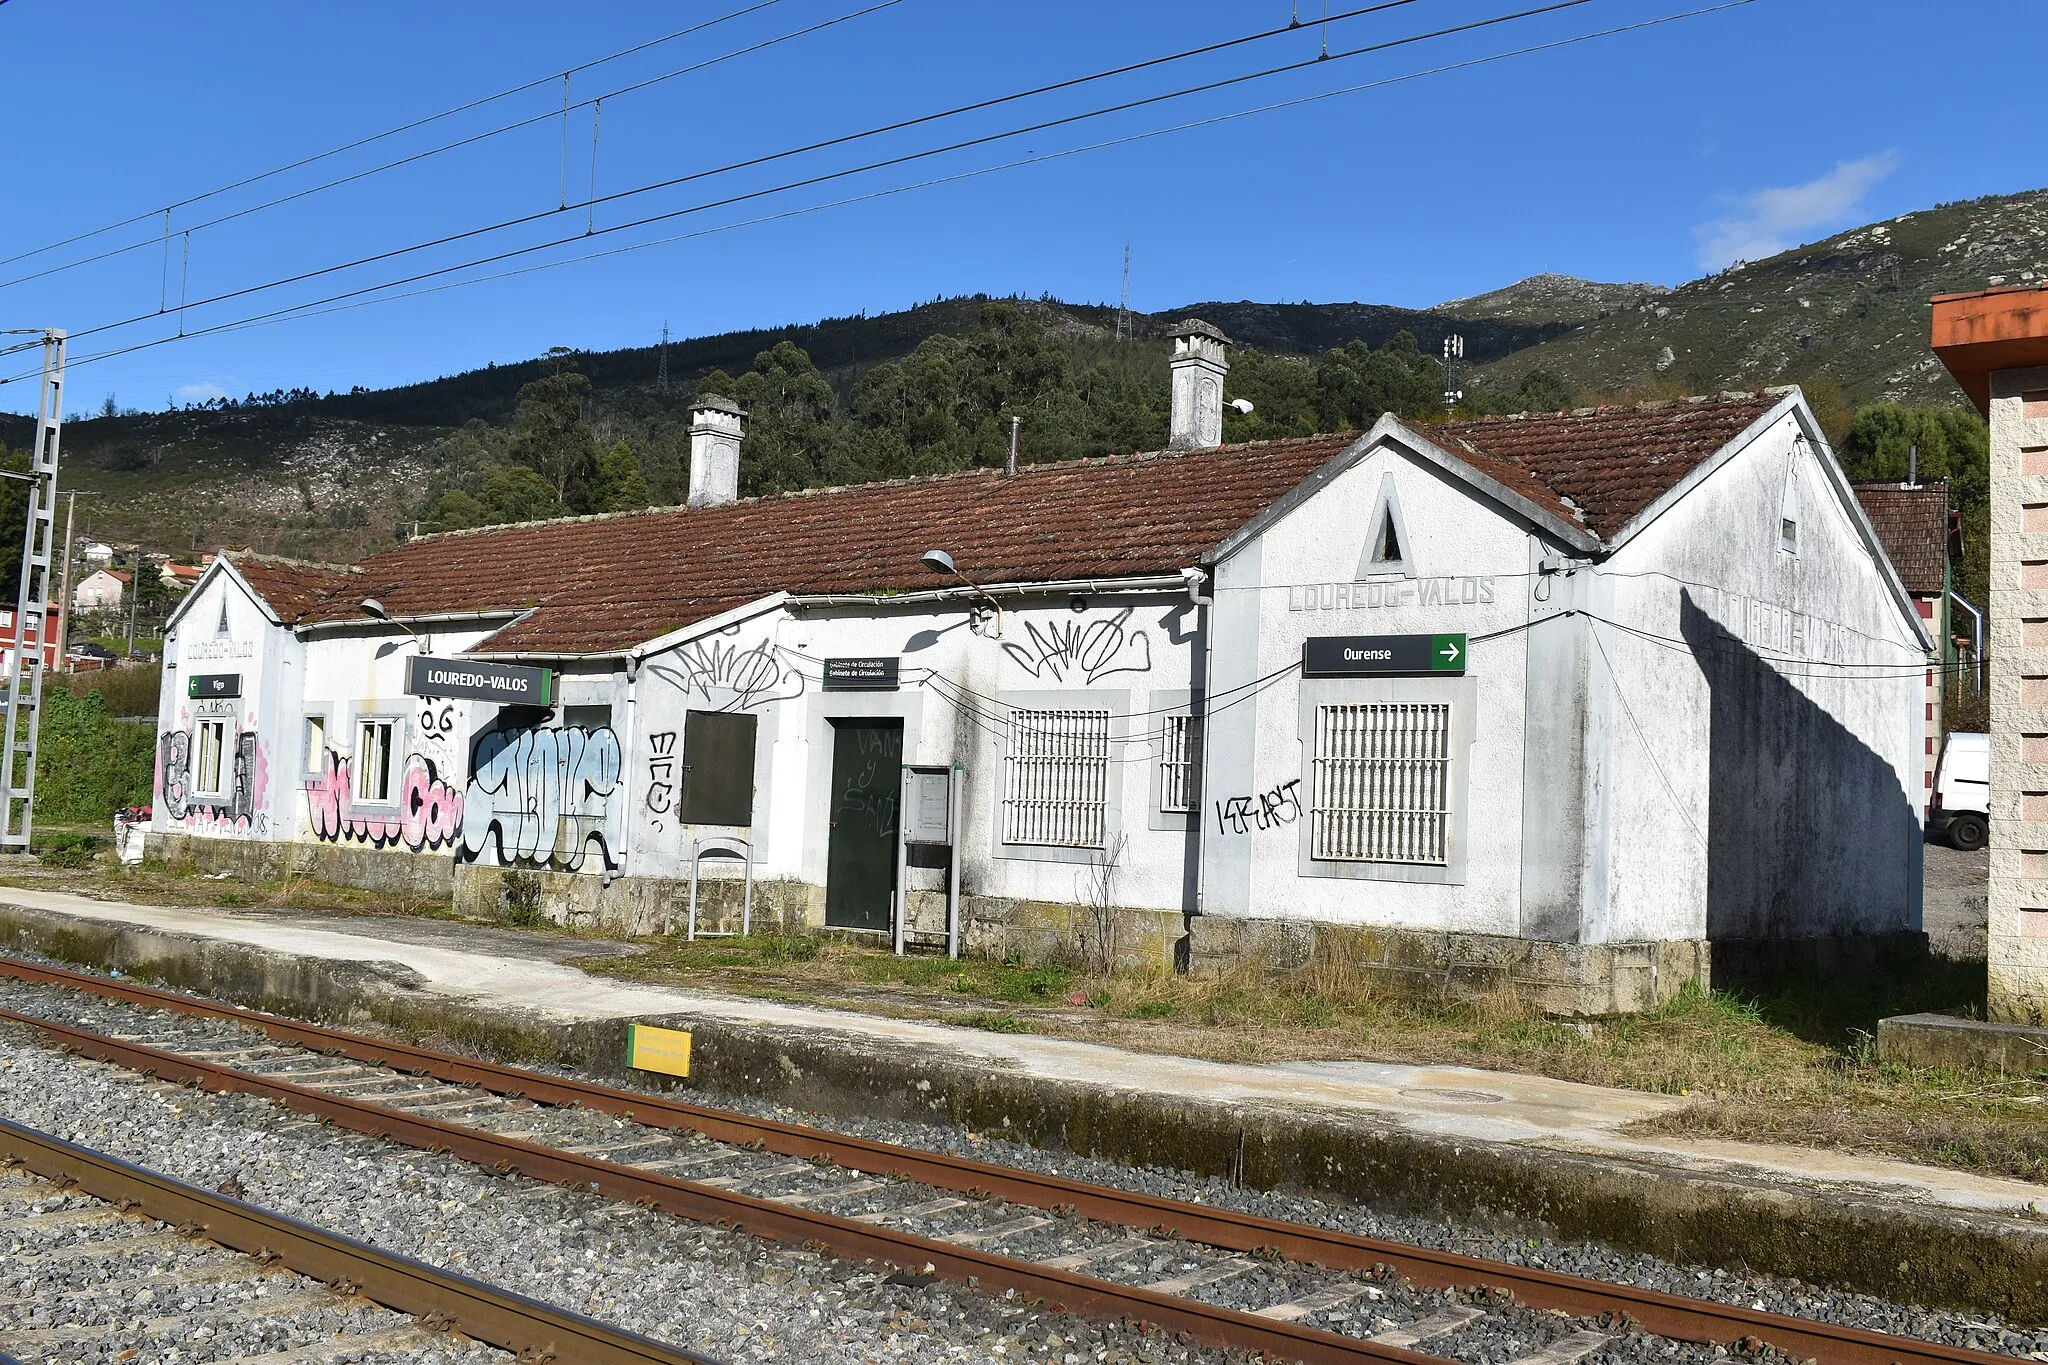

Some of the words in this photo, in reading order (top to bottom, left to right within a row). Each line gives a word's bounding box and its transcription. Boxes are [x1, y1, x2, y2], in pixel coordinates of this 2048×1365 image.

[1289, 576, 1495, 611] LOUREDO-VALOS
[1343, 647, 1392, 661] Ourense
[858, 660, 884, 668] Circulación
[213, 680, 225, 691] Vigo
[427, 669, 528, 692] LOUREDO-VALOS
